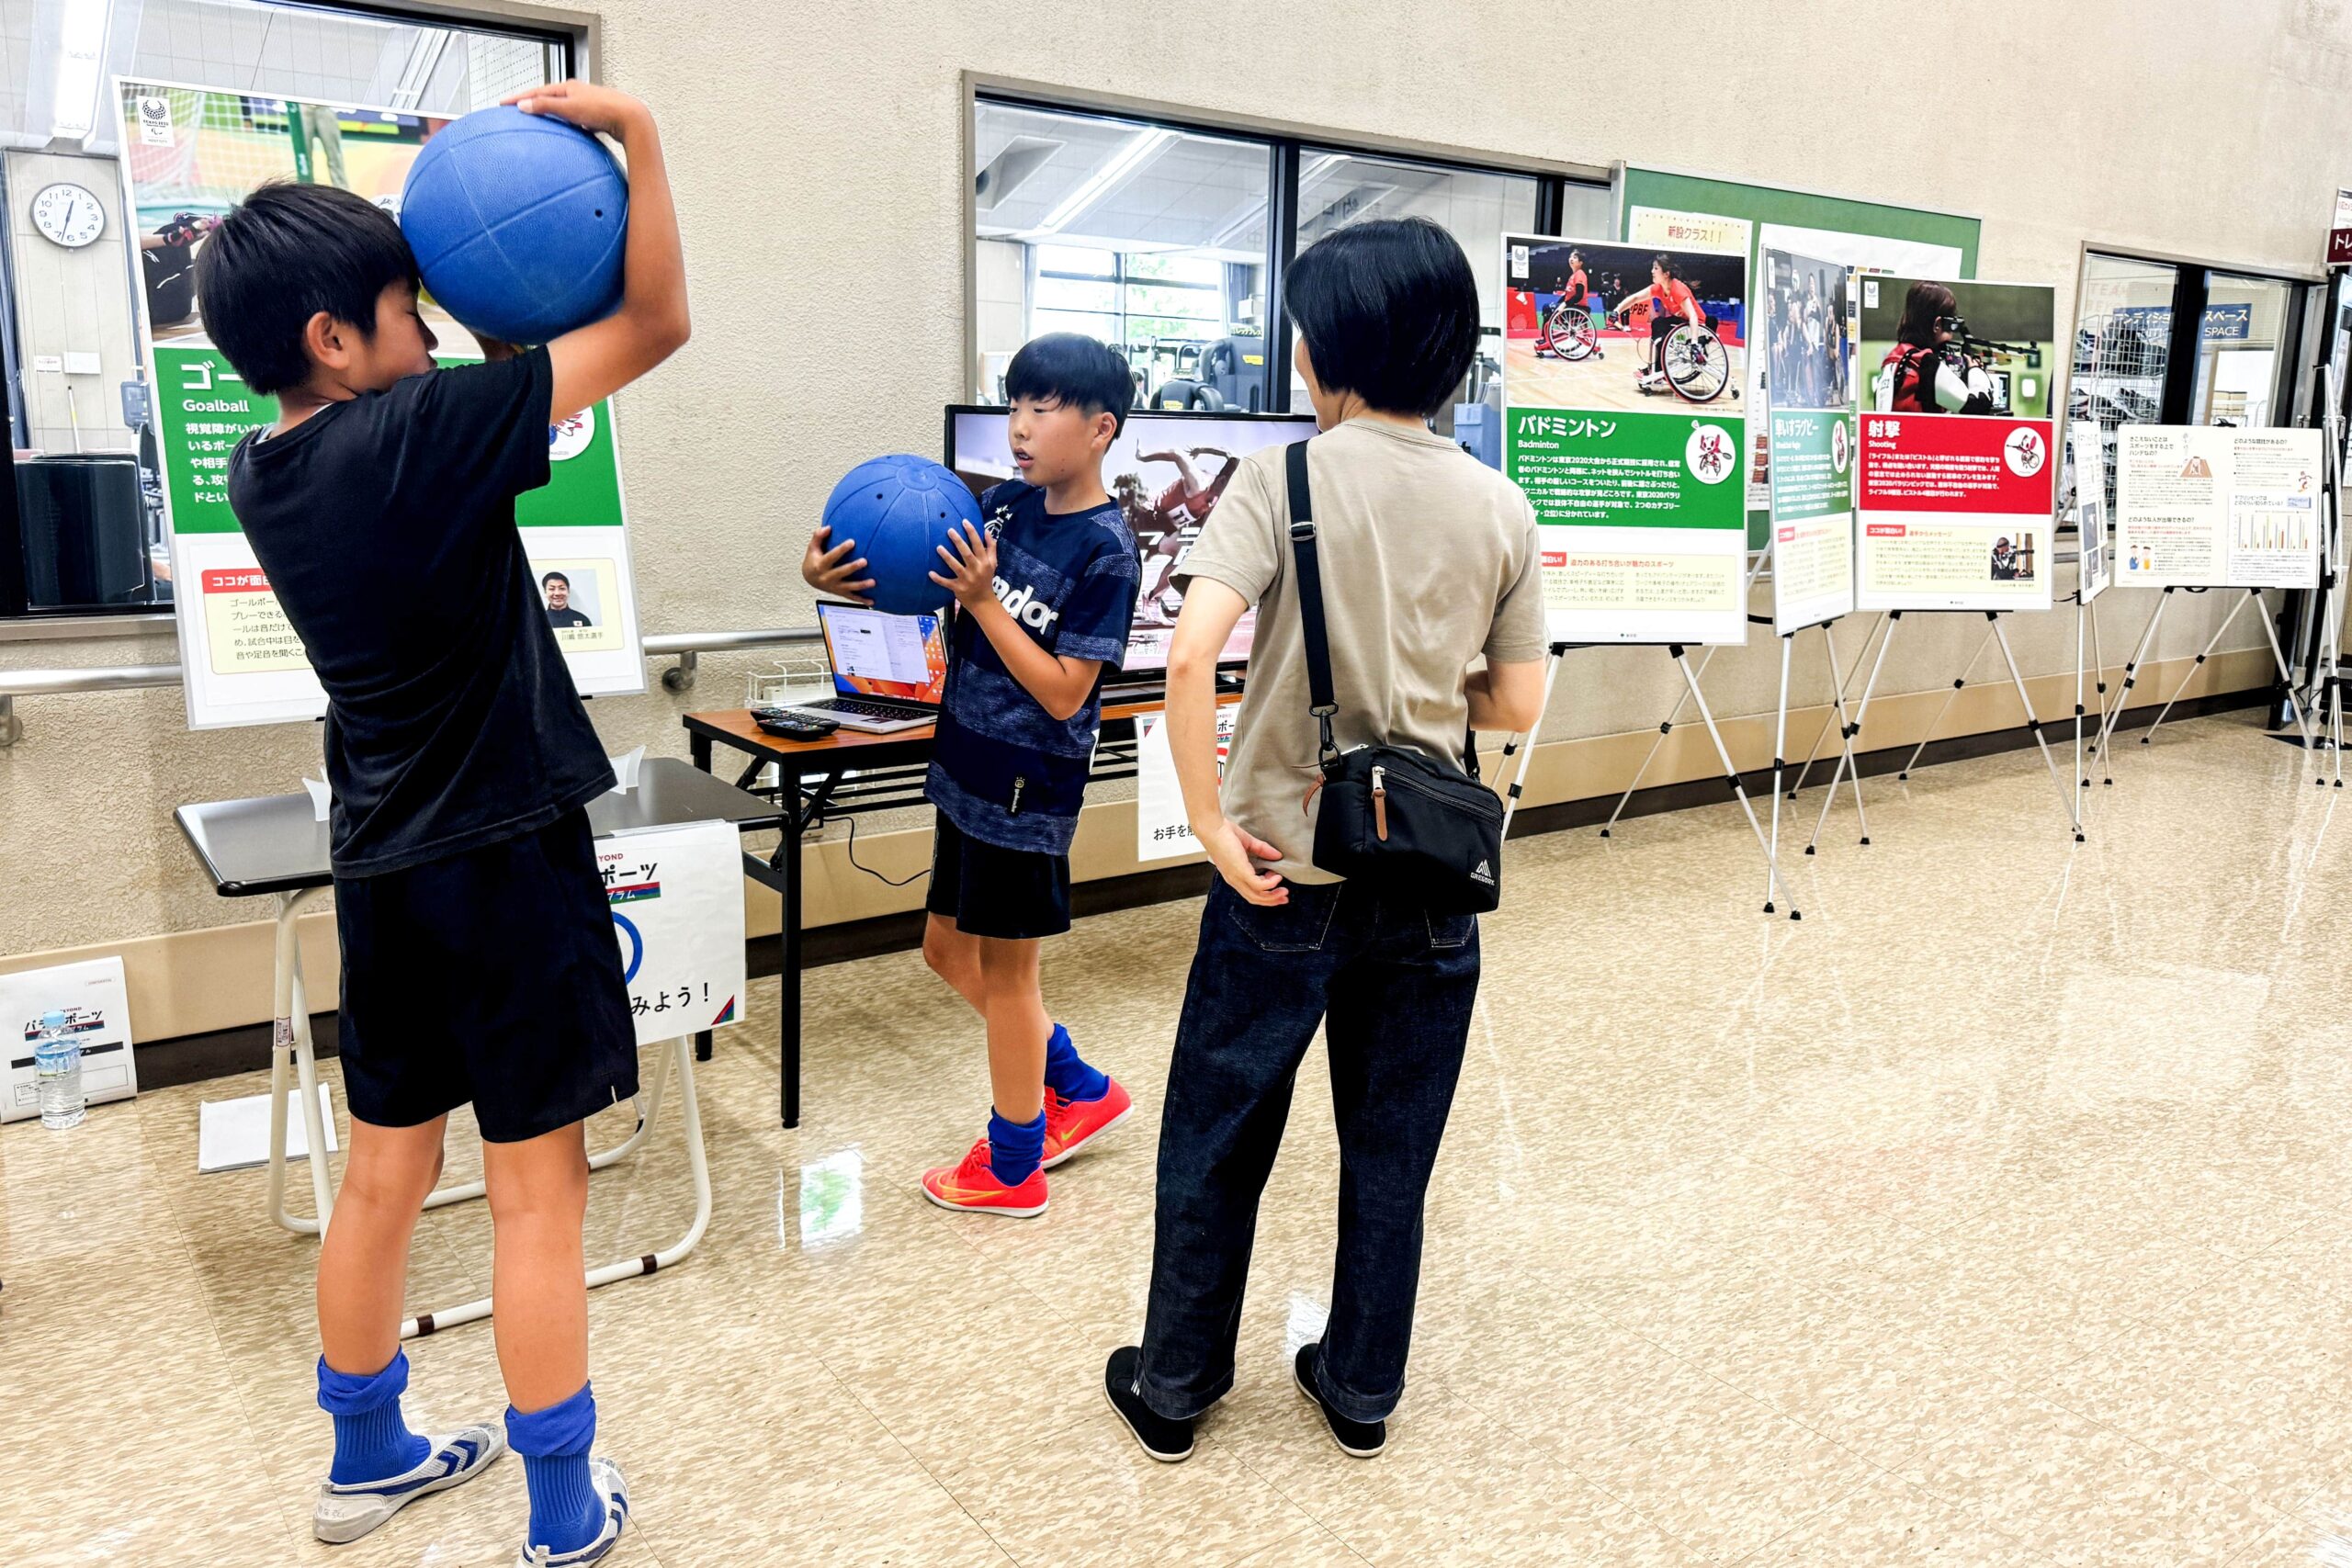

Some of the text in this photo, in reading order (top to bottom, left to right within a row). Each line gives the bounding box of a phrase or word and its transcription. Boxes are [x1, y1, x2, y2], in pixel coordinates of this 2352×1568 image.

[39, 209, 48, 218] 9
[1668, 226, 1722, 243] 新設クラス！！
[2335, 233, 2352, 250] トレ
[2205, 309, 2248, 321] スペース
[2204, 326, 2240, 337] SPACE
[181, 360, 243, 389] ゴー
[182, 400, 250, 412] Goalball
[186, 423, 266, 434] 視覚障がいの
[1518, 415, 1617, 438] バドミントン
[1775, 419, 1819, 437] 車いすラグビー
[1868, 420, 1901, 438] 射撃
[187, 440, 236, 451] いるボー
[1518, 440, 1559, 449] Badminton
[1868, 441, 1896, 449] Shooting
[190, 457, 228, 468] や相手
[192, 474, 228, 486] る、攻
[194, 492, 229, 502] ドとい
[230, 597, 278, 607] ゴールボー
[992, 575, 1059, 636] ador
[231, 611, 286, 620] プレーできる
[236, 648, 306, 660] 音や足音を聞くこ
[1217, 720, 1235, 732] ポー
[598, 852, 624, 862] YOND
[600, 863, 658, 886] ポーツ
[1470, 872, 1495, 886] GREGORY
[631, 982, 708, 1016] みよう！
